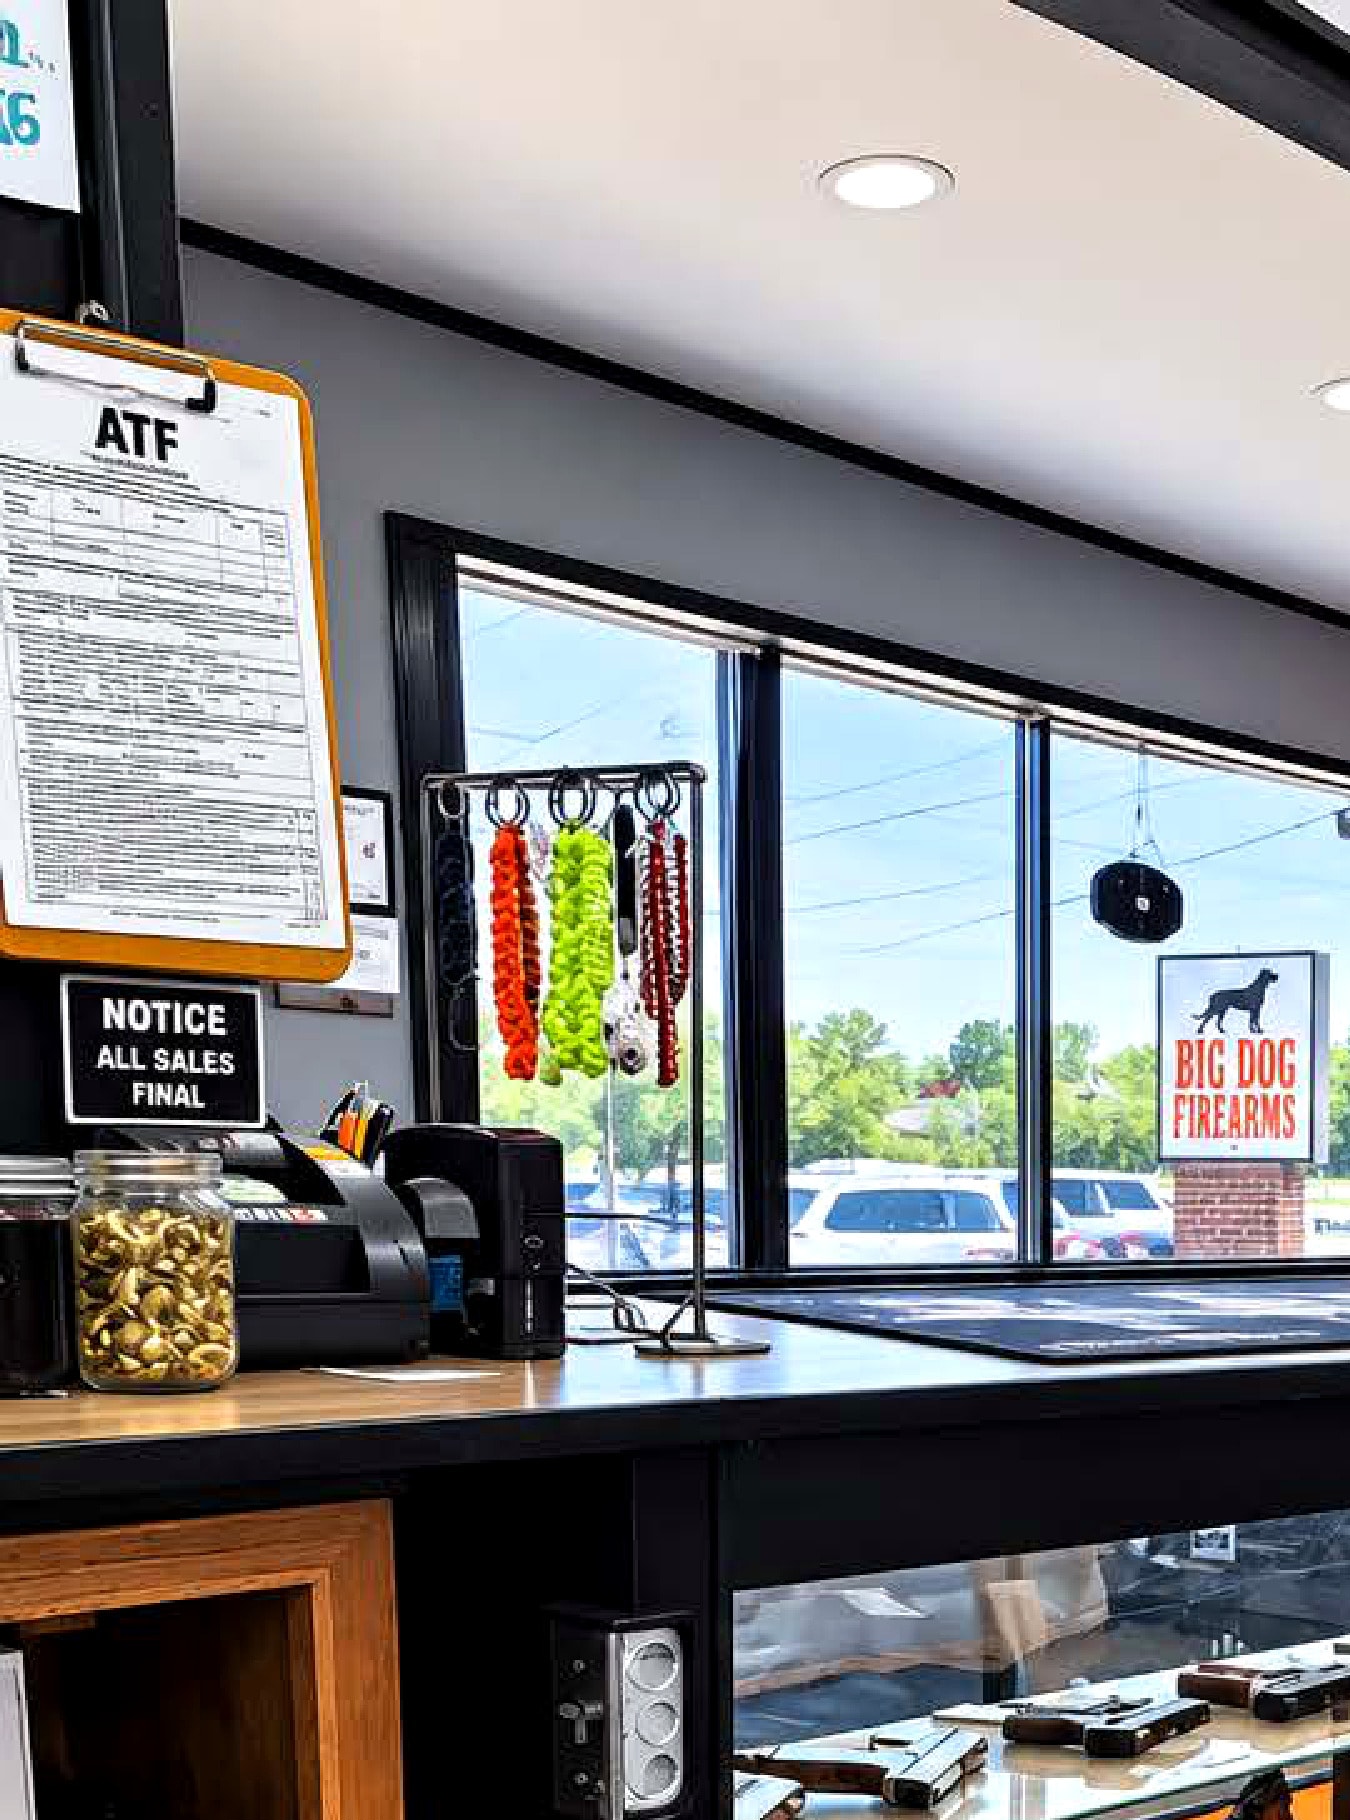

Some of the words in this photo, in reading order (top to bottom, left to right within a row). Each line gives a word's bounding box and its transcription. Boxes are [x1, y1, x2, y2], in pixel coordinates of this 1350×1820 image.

[95, 406, 179, 461] ATF
[102, 998, 228, 1037] NOTICE
[97, 1045, 146, 1072] ALL
[153, 1048, 236, 1076] SALES
[1175, 1038, 1225, 1089] BIG
[1237, 1038, 1296, 1089] DOG
[132, 1082, 206, 1109] FINAL
[1173, 1094, 1297, 1139] FIREARMS
